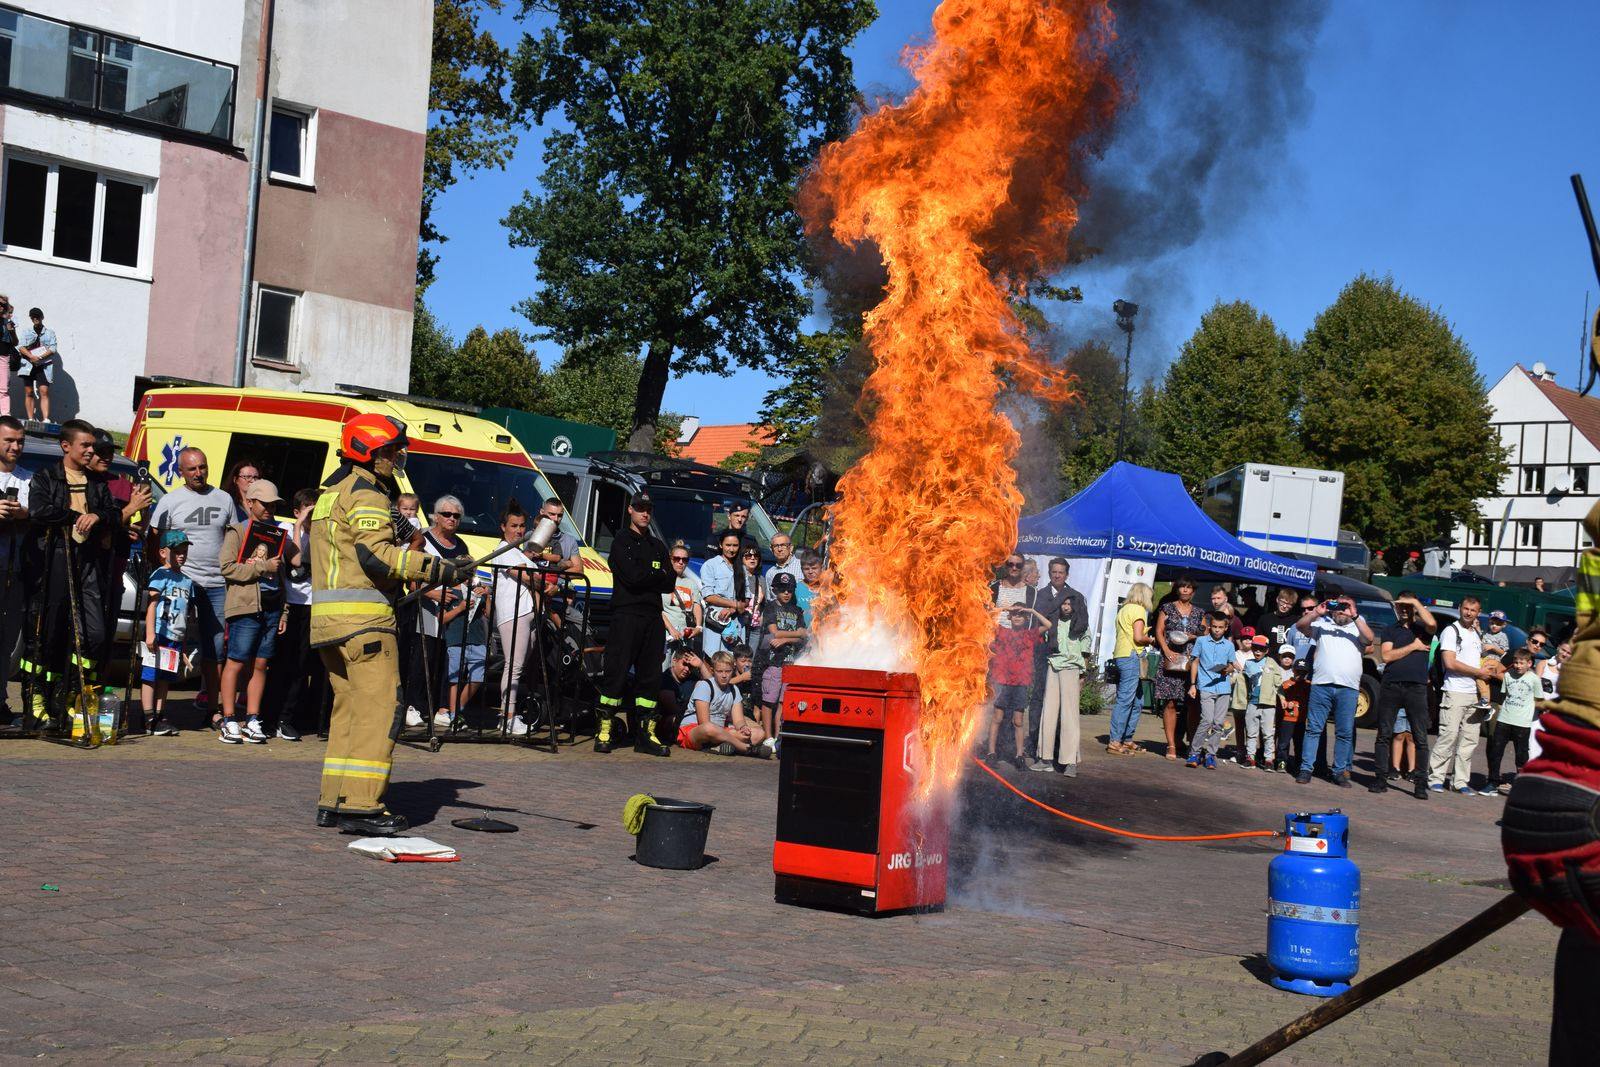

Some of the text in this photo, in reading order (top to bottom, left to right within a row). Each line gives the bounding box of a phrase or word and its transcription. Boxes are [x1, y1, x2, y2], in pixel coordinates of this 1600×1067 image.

[361, 519, 377, 528] PSP
[1045, 534, 1108, 549] radiotechniczny
[1116, 534, 1125, 549] 8
[1200, 548, 1240, 566] batalion
[1244, 557, 1316, 584] radiotechniczny
[887, 852, 912, 870] JRG
[1299, 945, 1312, 957] kg
